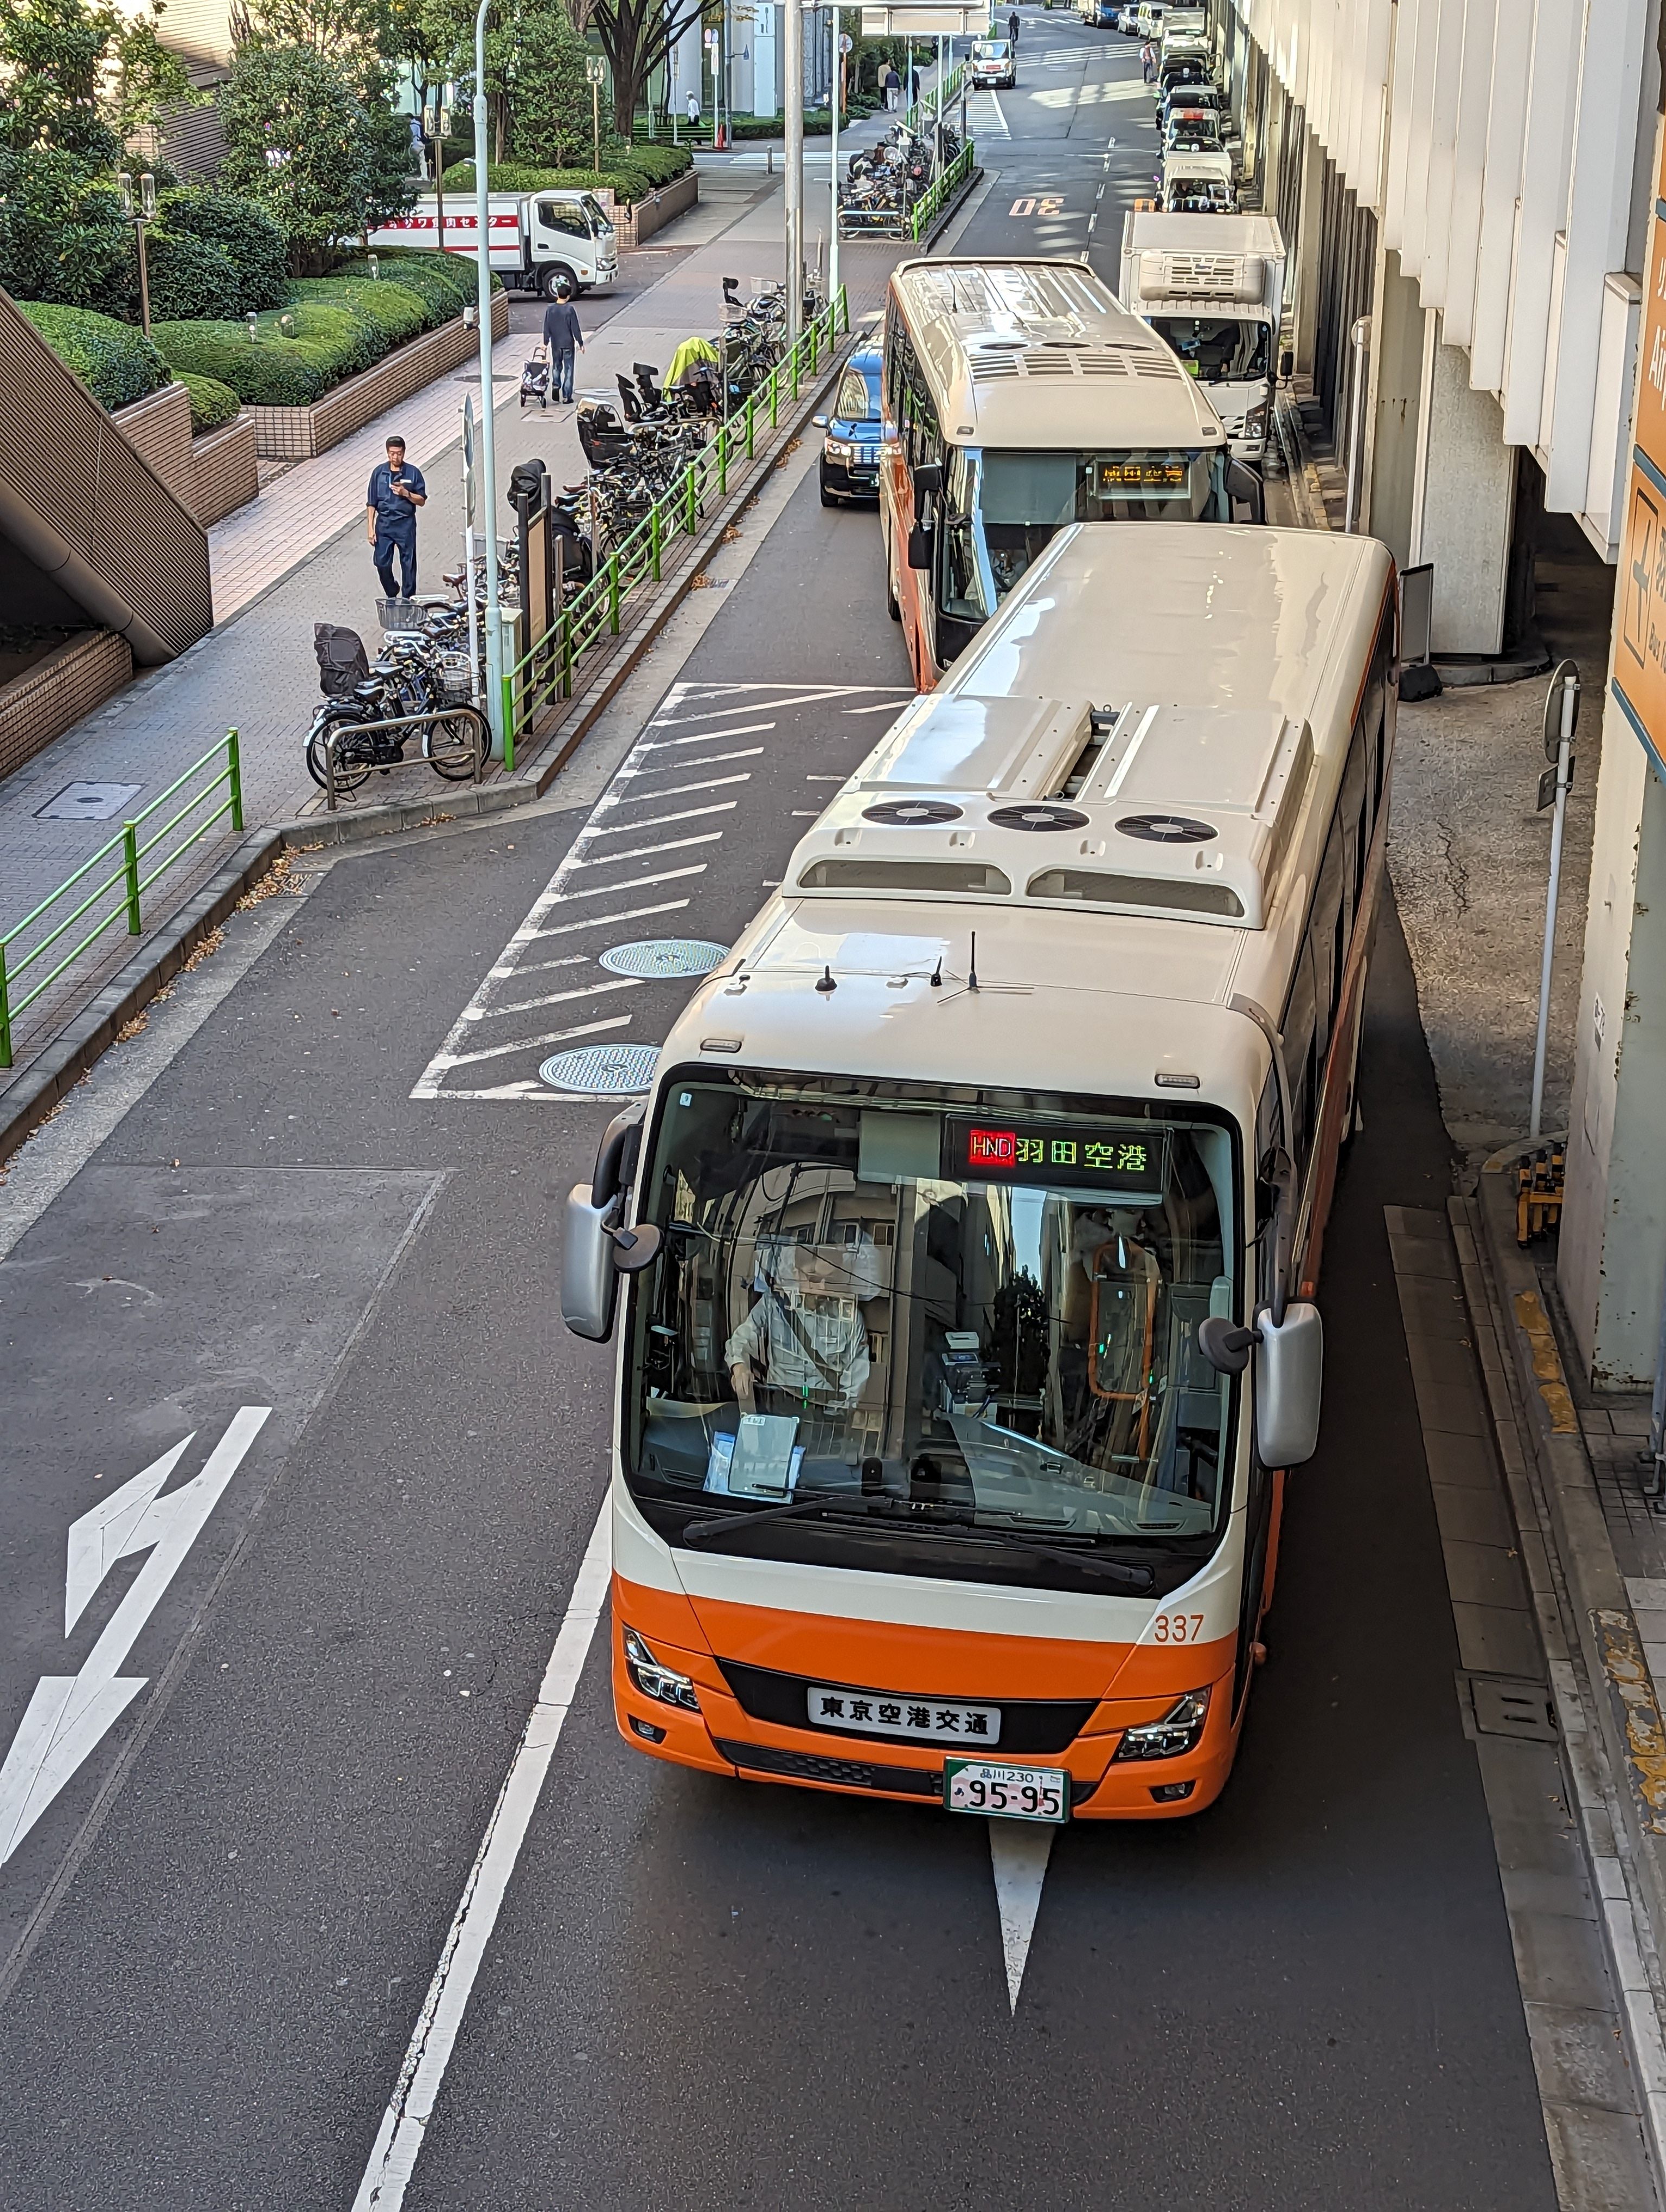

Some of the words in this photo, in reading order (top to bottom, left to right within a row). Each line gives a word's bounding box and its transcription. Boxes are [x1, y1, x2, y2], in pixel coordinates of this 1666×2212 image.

[974, 1136, 1011, 1157] HND
[1016, 1139, 1147, 1171] 羽田空港
[1155, 1615, 1204, 1642] 337
[819, 1696, 989, 1735] 東京空港交通
[969, 1780, 1060, 1815] 95-95
